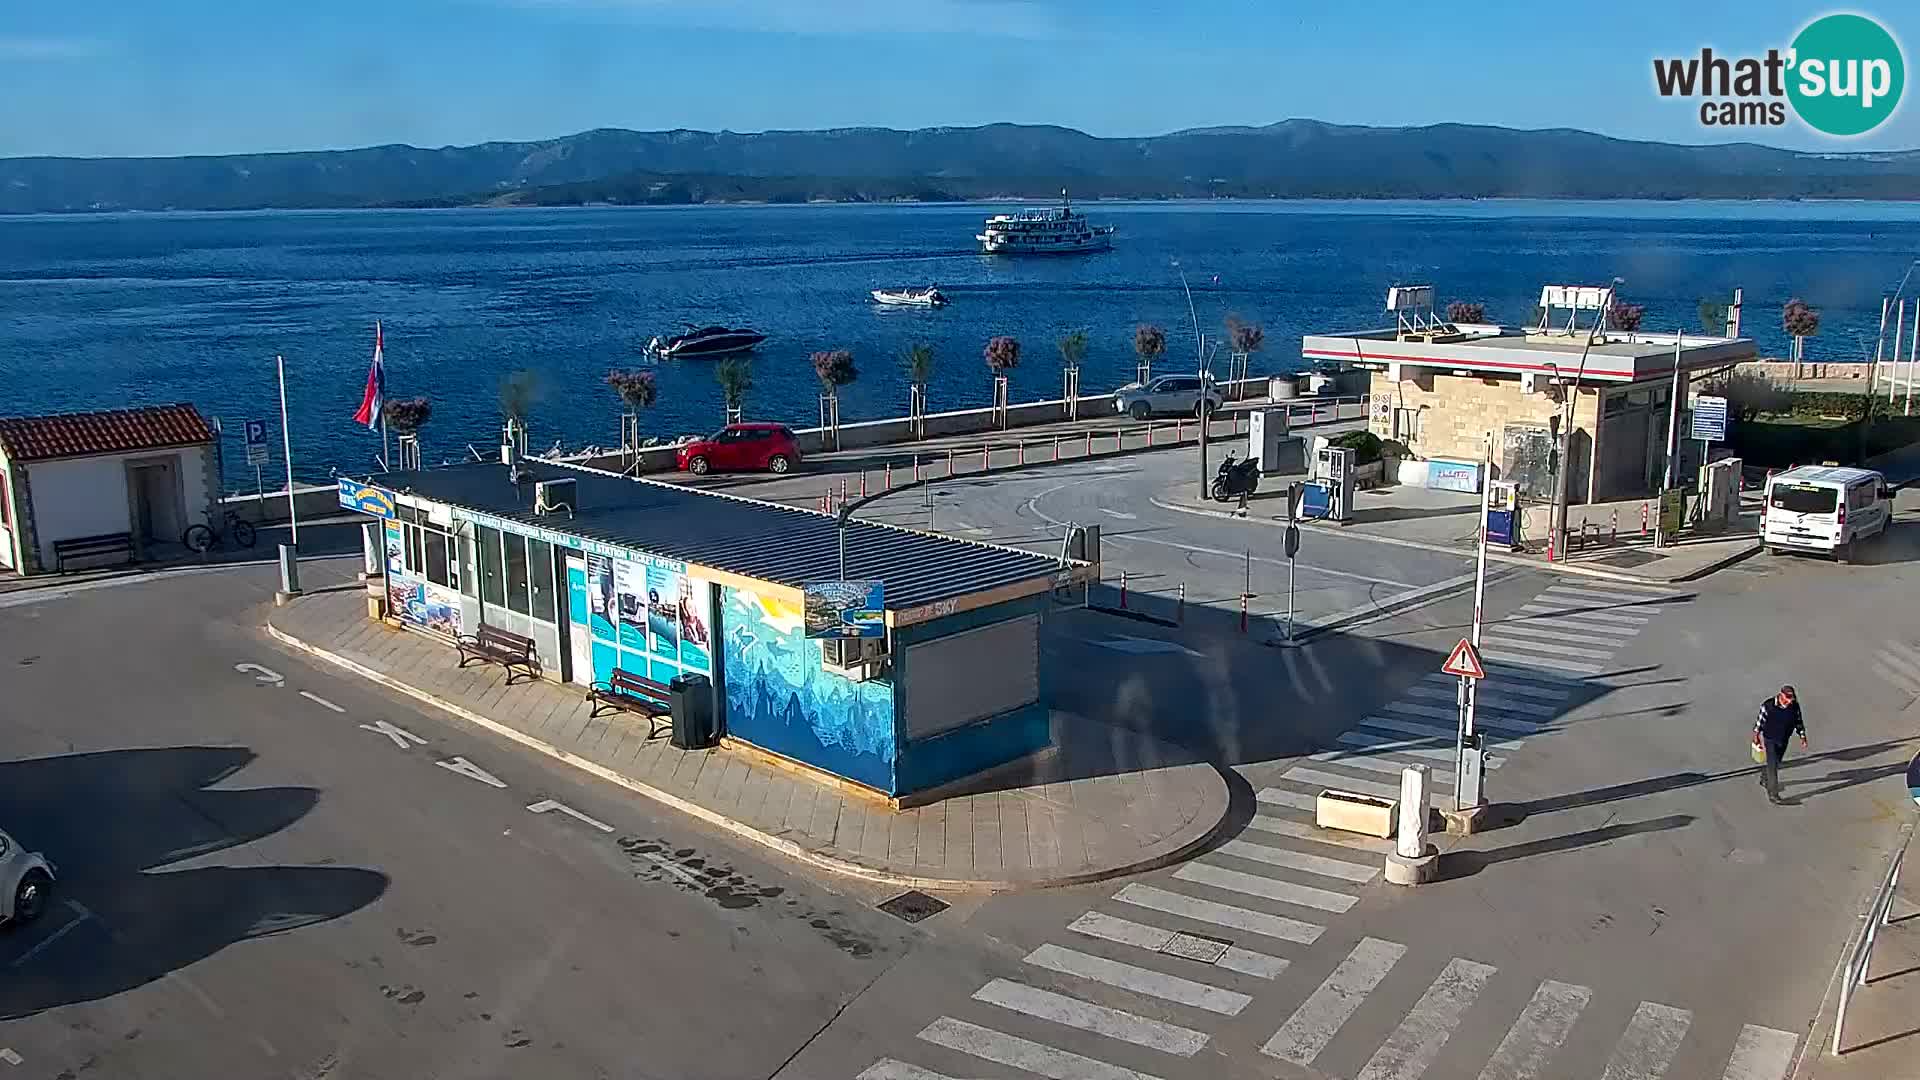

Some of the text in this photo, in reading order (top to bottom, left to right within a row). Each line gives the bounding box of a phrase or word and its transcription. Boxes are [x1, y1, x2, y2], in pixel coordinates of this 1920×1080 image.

[251, 424, 262, 441] P
[595, 543, 627, 559] STATION
[629, 551, 653, 566] TICKET
[655, 557, 681, 572] OFFICE
